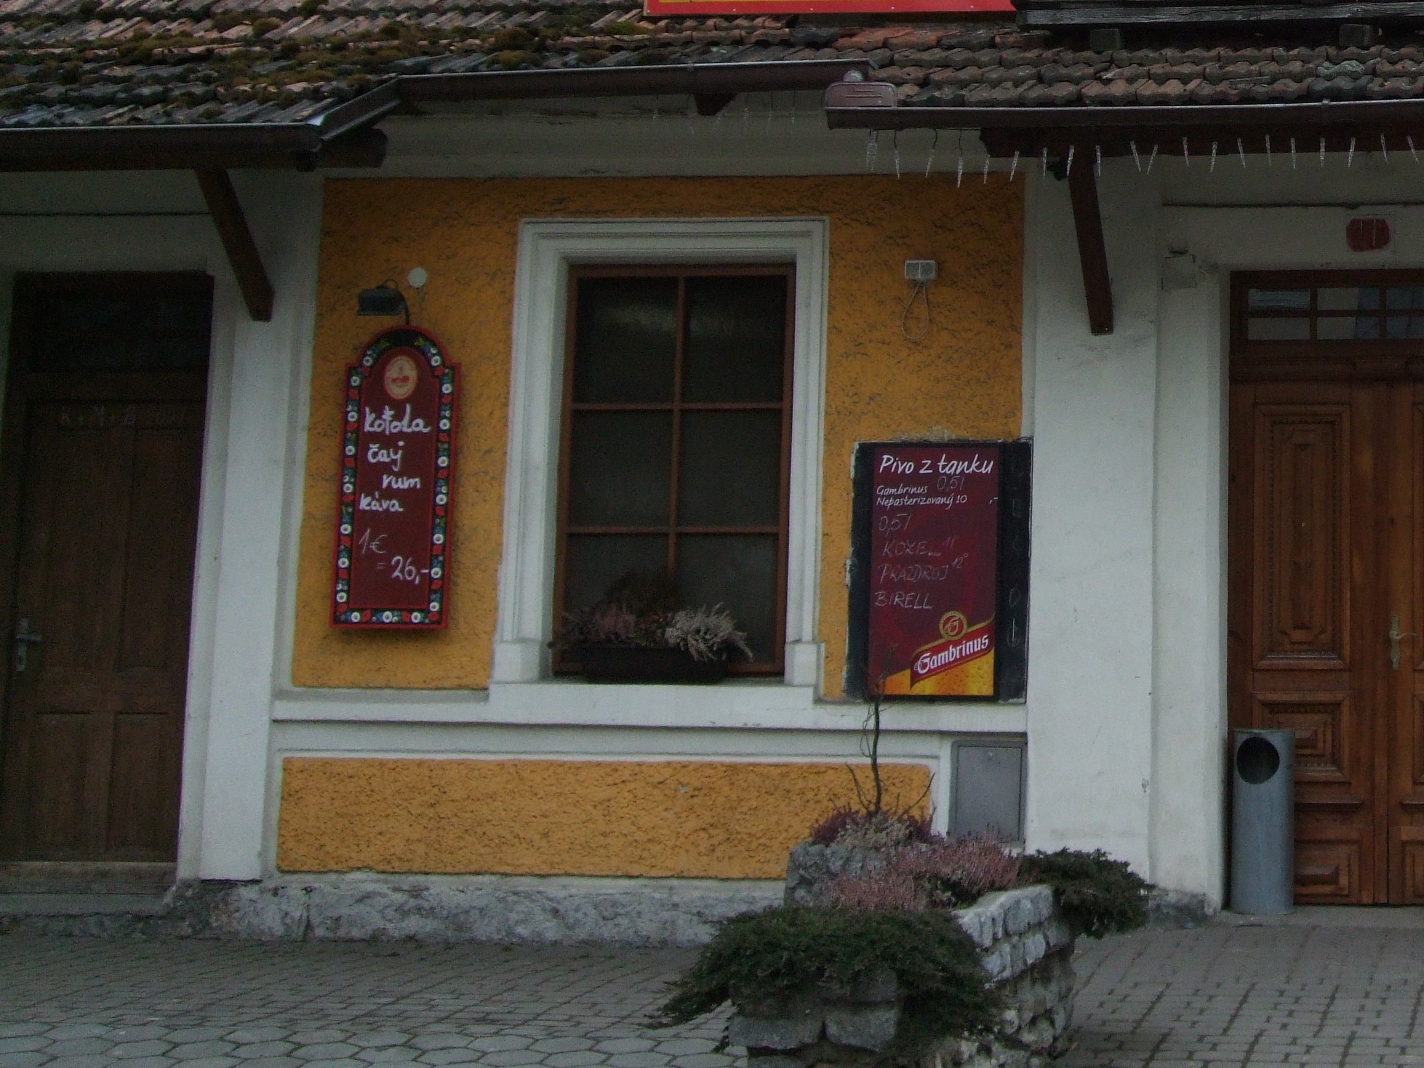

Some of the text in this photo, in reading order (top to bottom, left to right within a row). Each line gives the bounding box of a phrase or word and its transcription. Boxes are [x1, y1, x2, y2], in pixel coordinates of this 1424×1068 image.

[879, 454, 915, 475] Pivo
[936, 453, 994, 475] tanku
[381, 473, 422, 490] rum
[876, 483, 929, 496] Gambrinus
[876, 492, 955, 510] Nepasterizovaný
[955, 494, 968, 504] 10
[874, 590, 933, 610] BIRELL
[913, 633, 990, 675] Gambrinus
